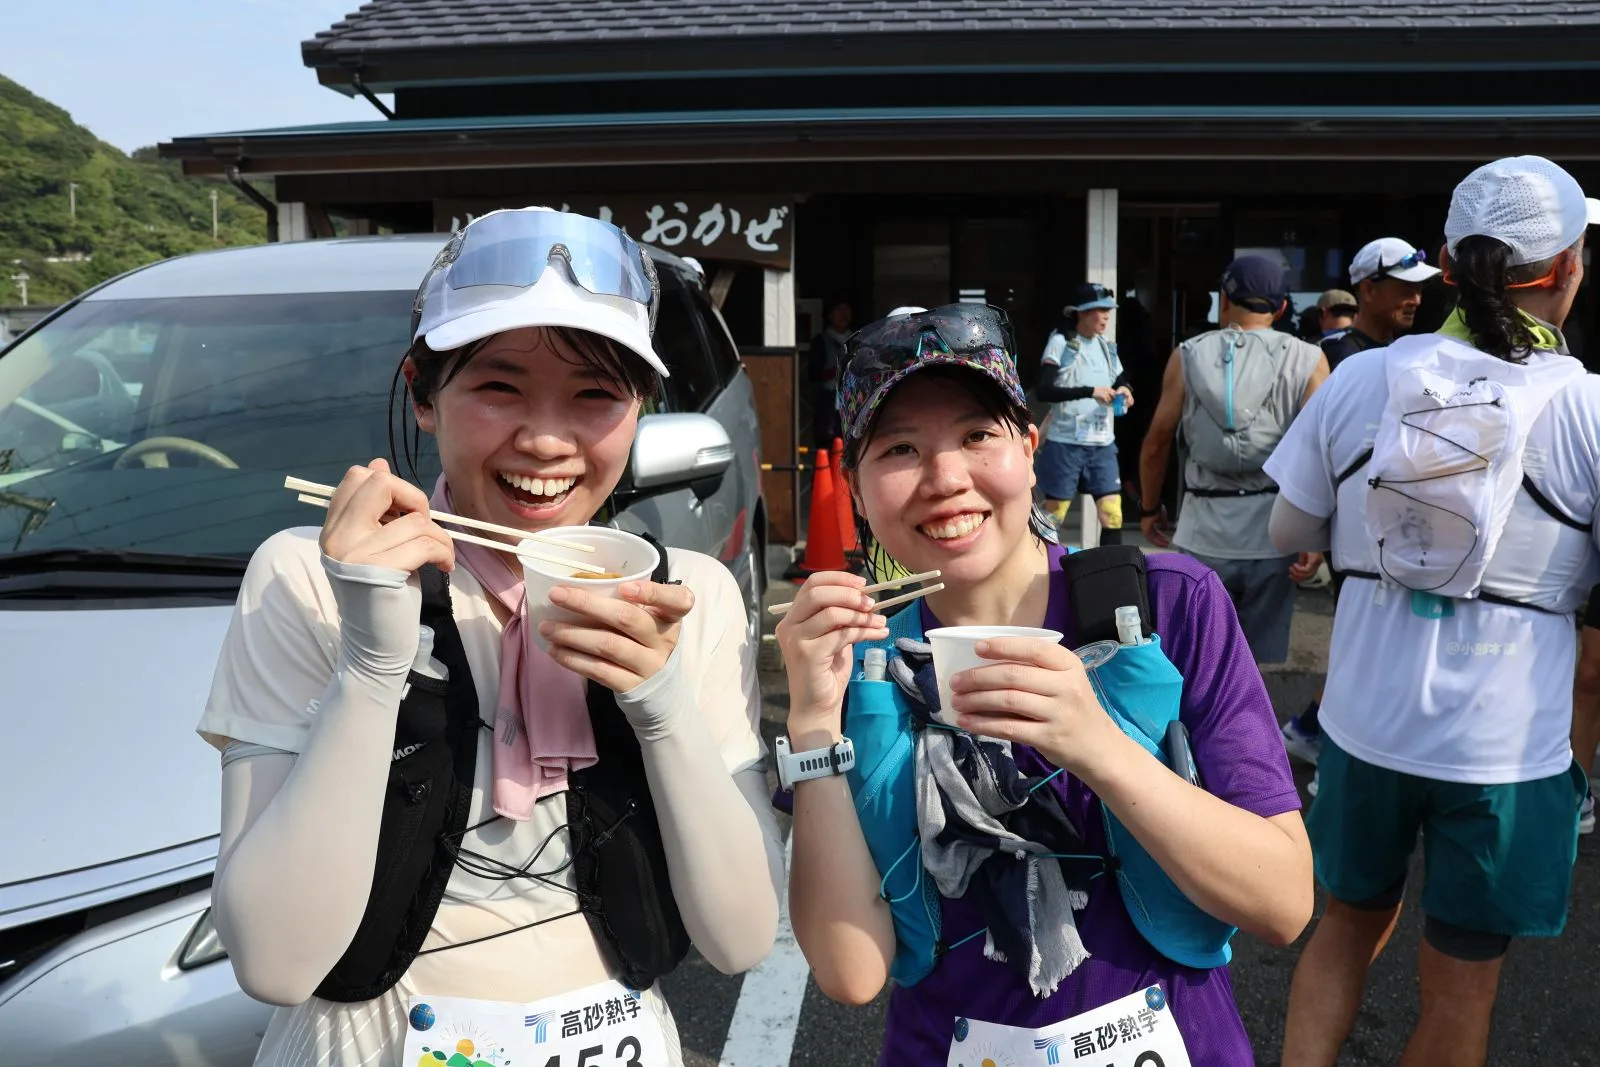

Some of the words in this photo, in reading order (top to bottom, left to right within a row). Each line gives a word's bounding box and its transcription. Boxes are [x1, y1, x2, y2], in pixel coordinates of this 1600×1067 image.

[561, 994, 641, 1038] 高砂熱学
[1071, 1008, 1159, 1058] 高砂熱学
